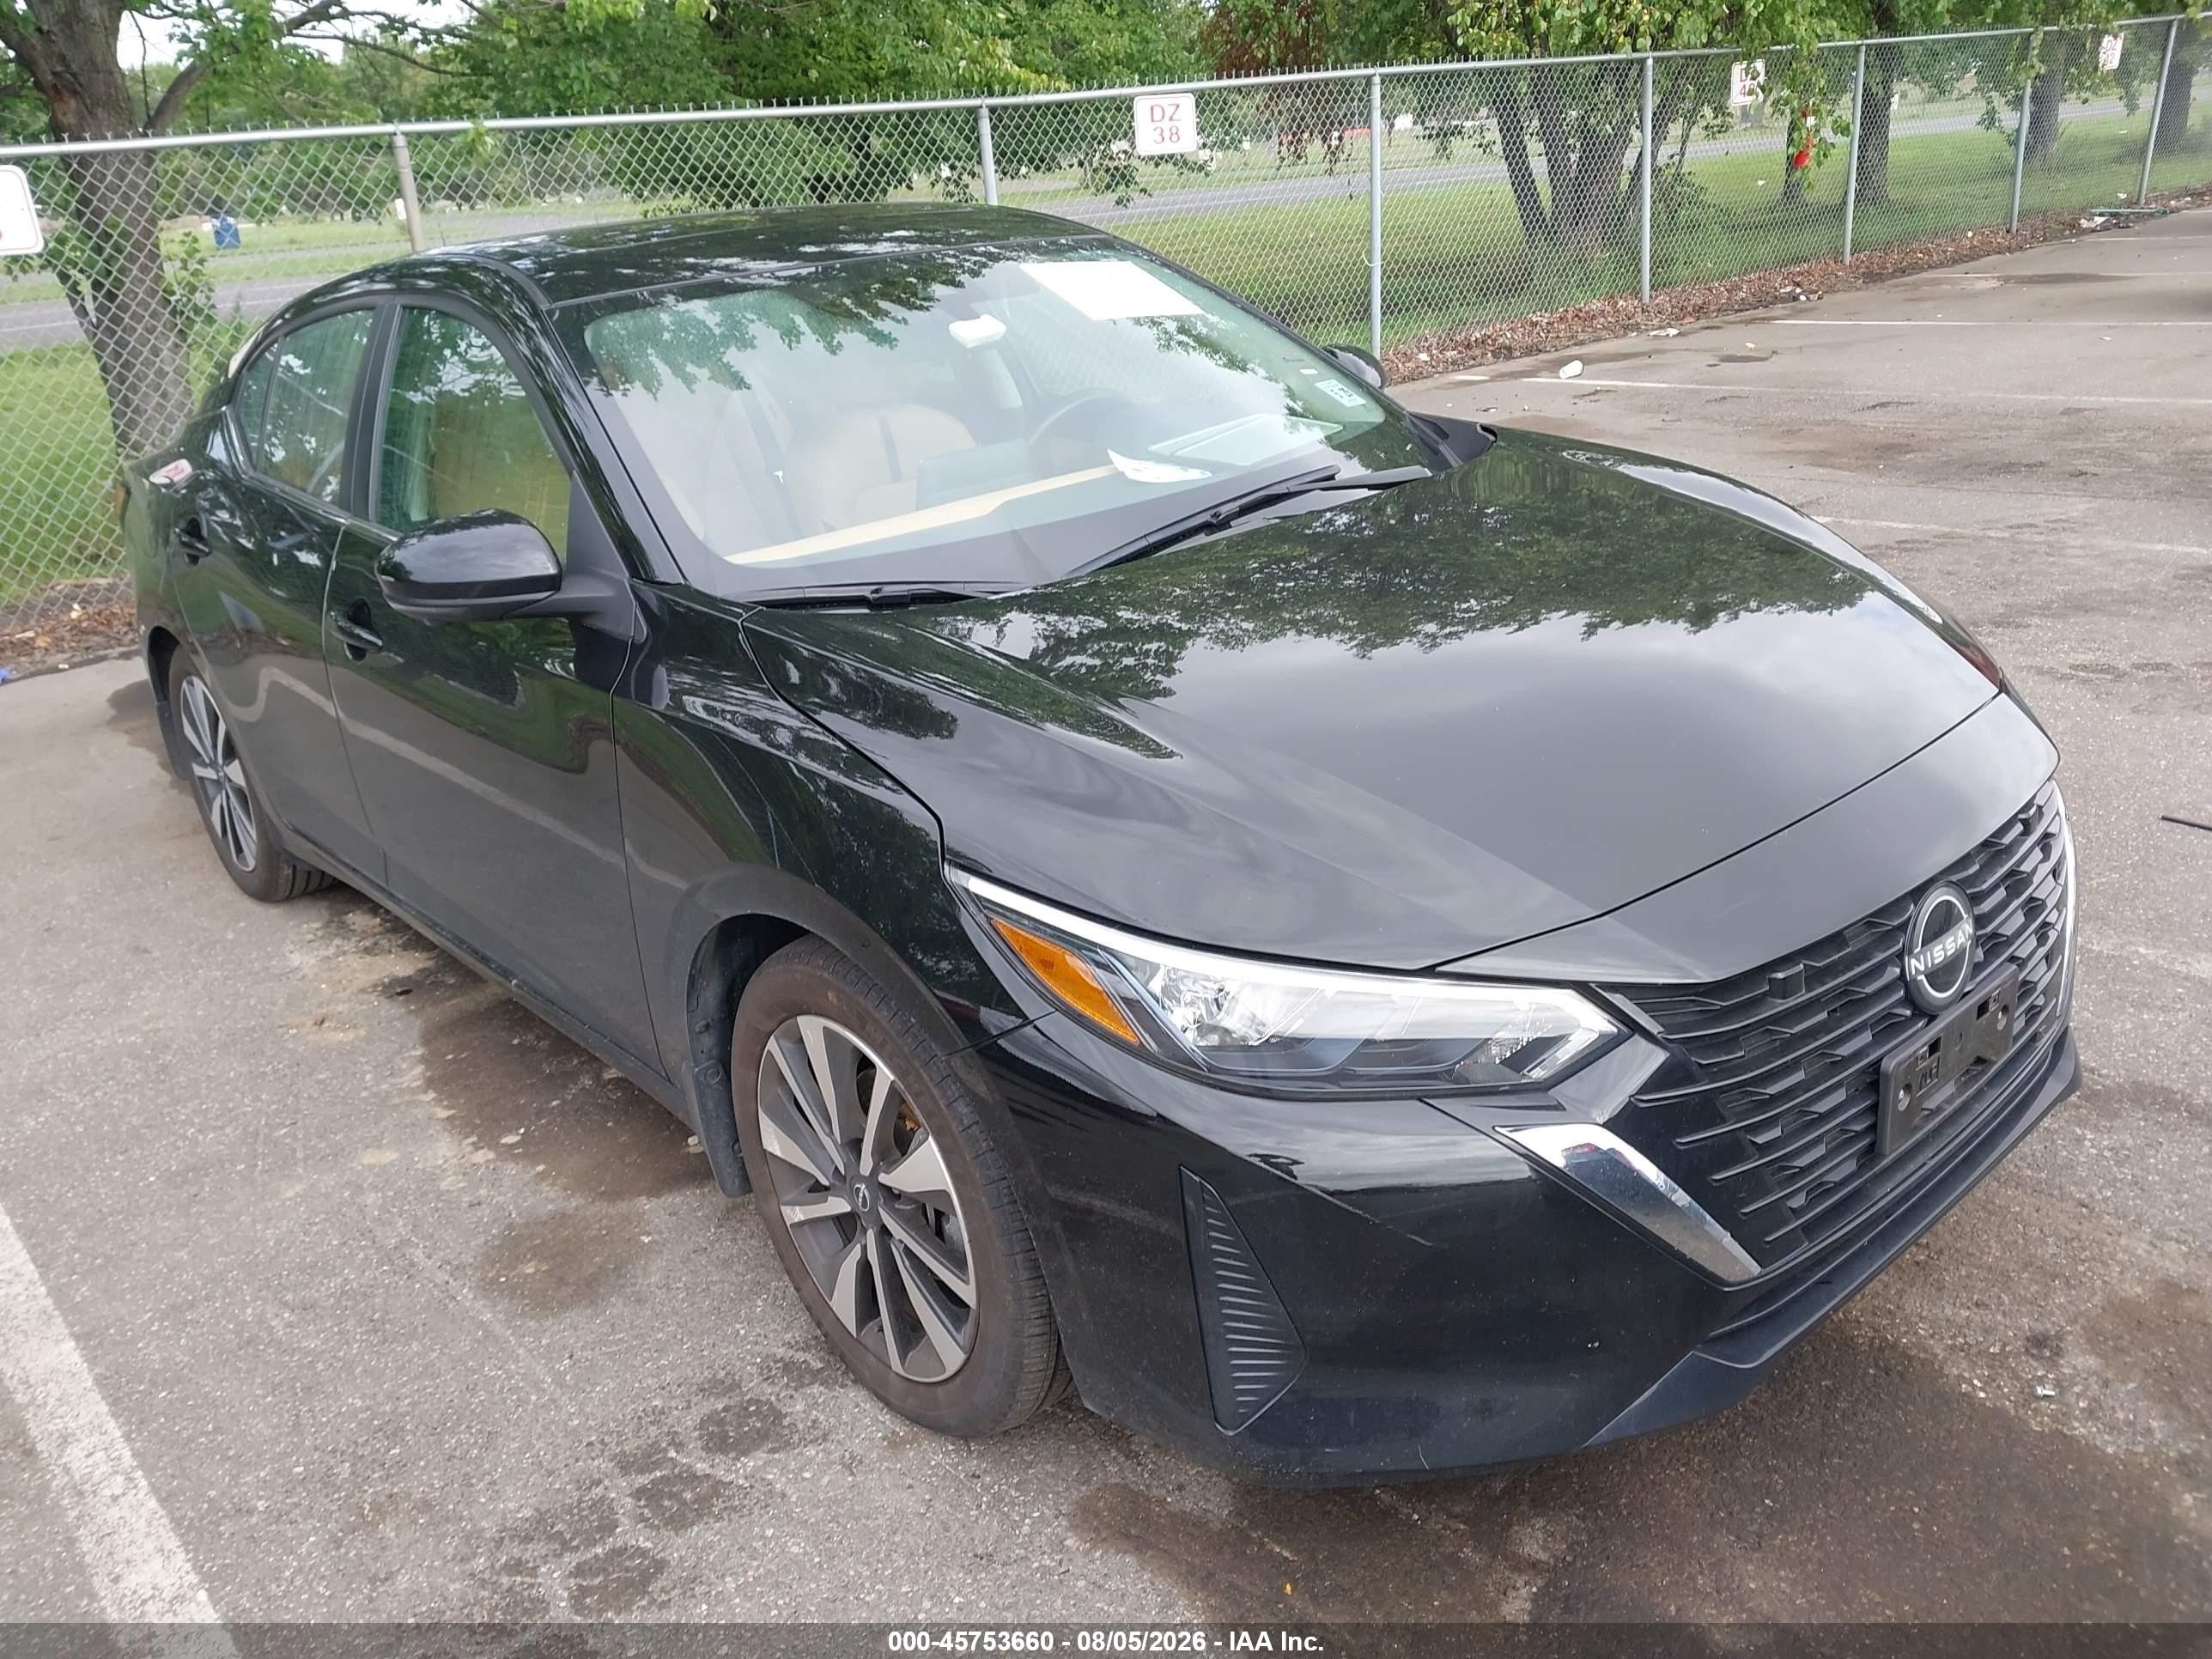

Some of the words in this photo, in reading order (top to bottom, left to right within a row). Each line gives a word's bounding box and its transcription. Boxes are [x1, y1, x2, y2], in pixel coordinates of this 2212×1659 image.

[1150, 103, 1182, 123] DZ
[1153, 125, 1181, 144] 38
[1910, 918, 1973, 975] NISSAN
